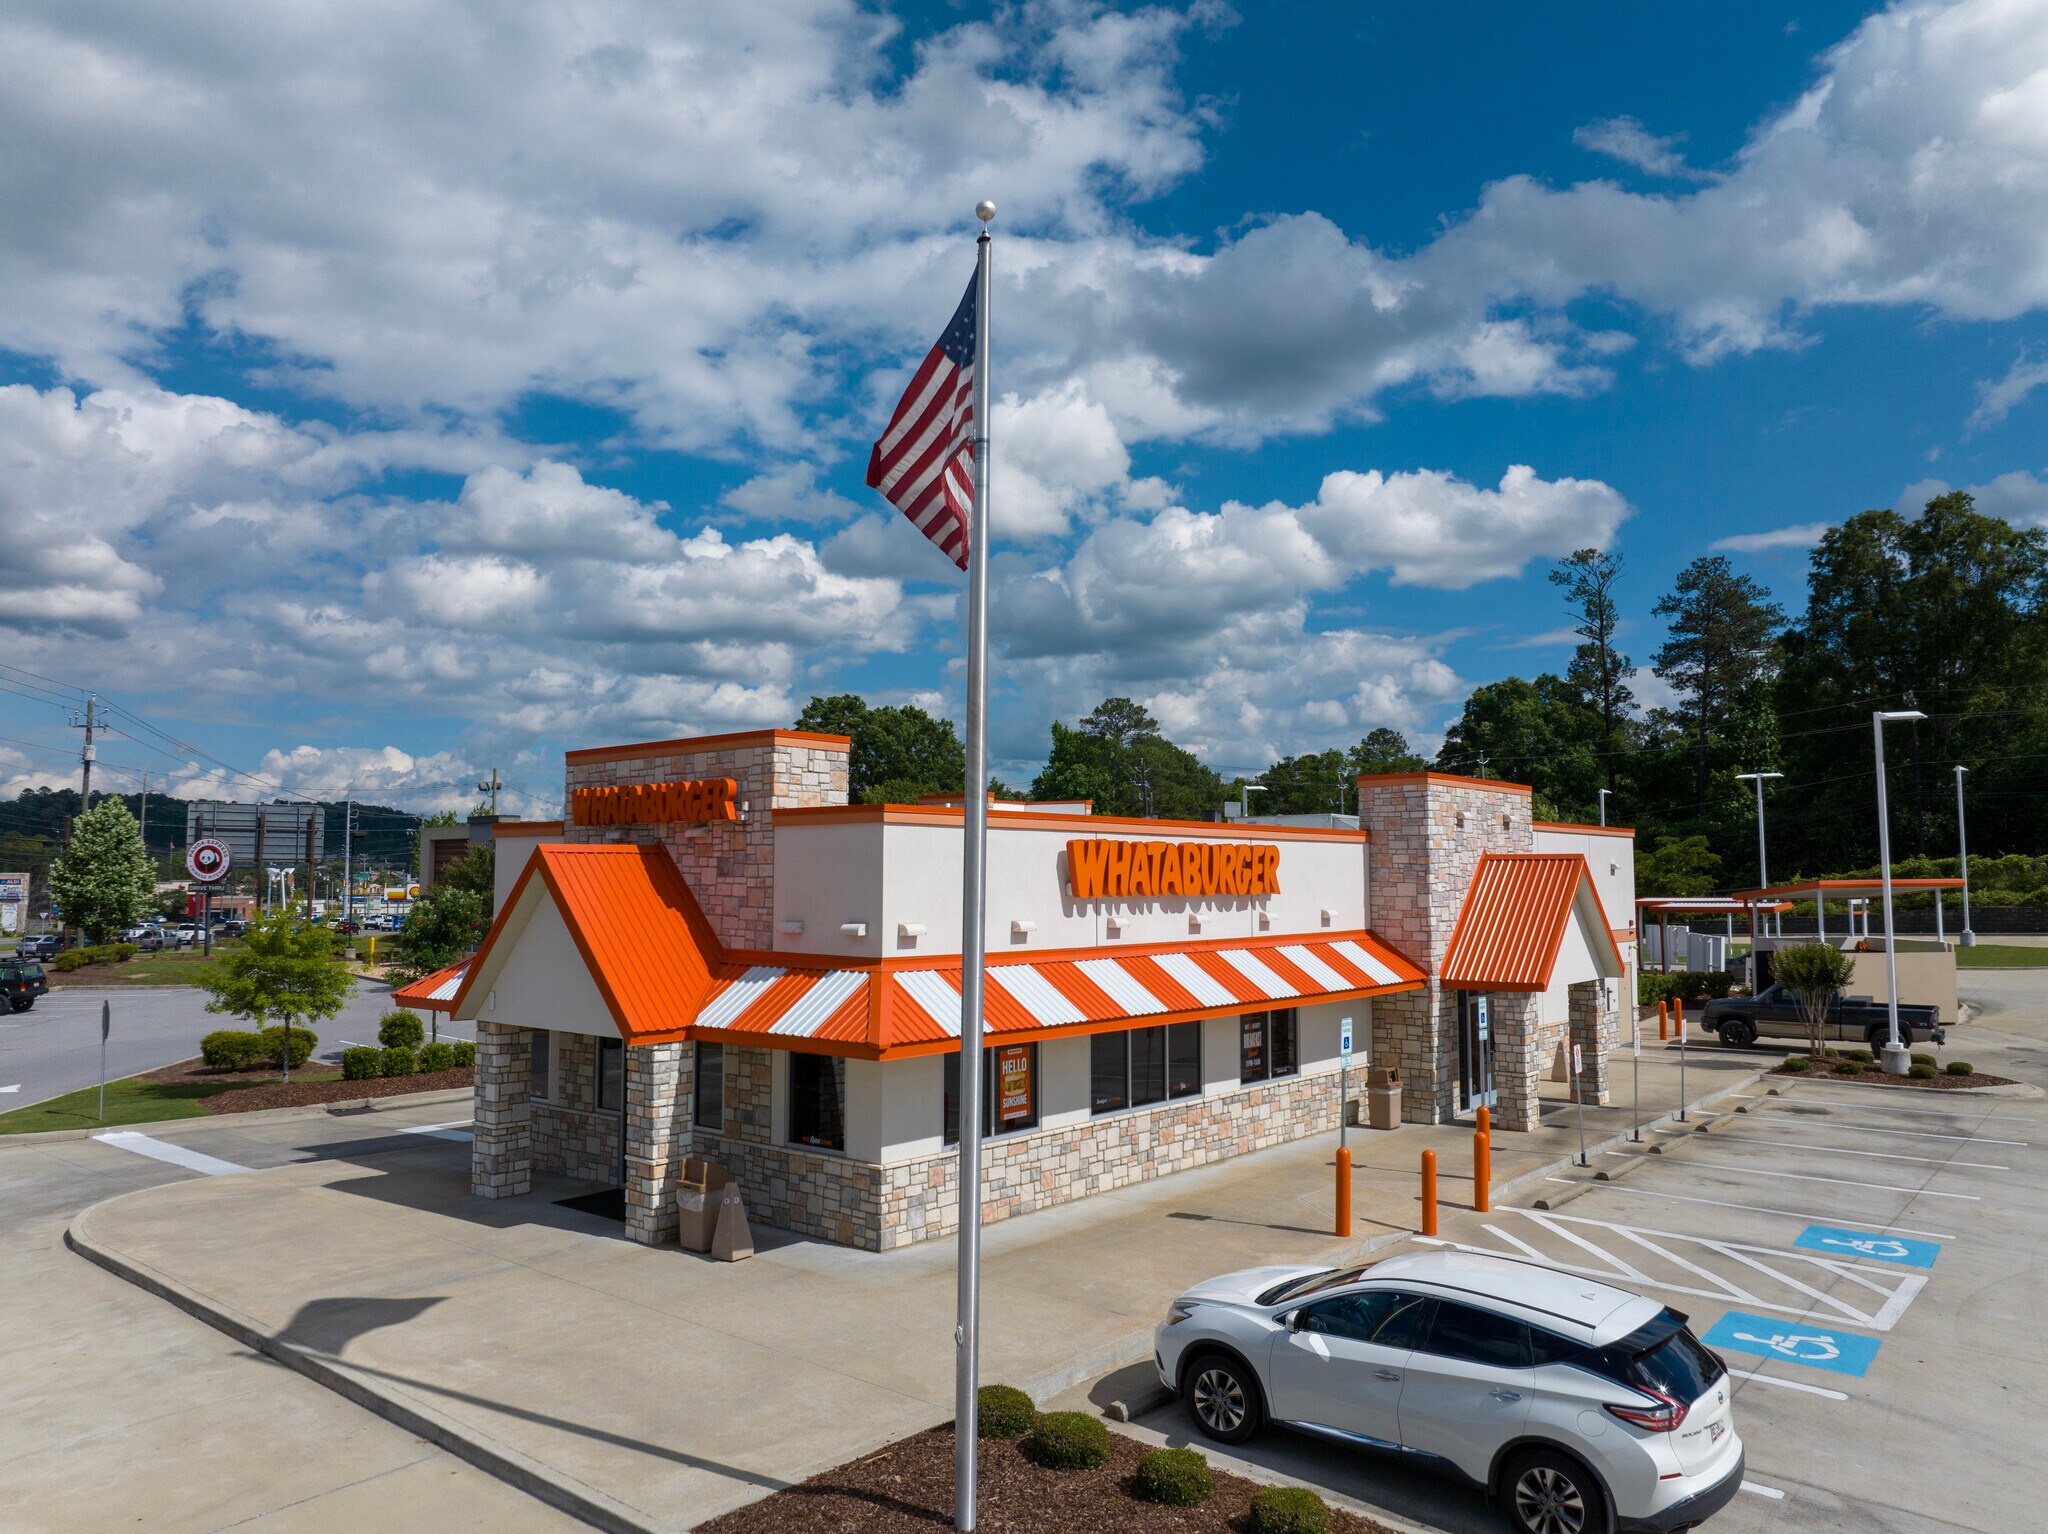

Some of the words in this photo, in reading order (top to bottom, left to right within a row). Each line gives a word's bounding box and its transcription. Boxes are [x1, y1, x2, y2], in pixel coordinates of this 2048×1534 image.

[572, 778, 737, 826] WHATABURGER
[189, 841, 205, 857] PANDA
[207, 840, 228, 858] EXPRESS
[189, 865, 207, 879] CHINESE
[208, 865, 227, 879] KITCHEN
[1066, 839, 1281, 899] WHATABURGER
[1002, 1057, 1027, 1075] HELLO
[1002, 1094, 1027, 1109] SUNSHINE
[809, 1135, 821, 1145] Open
